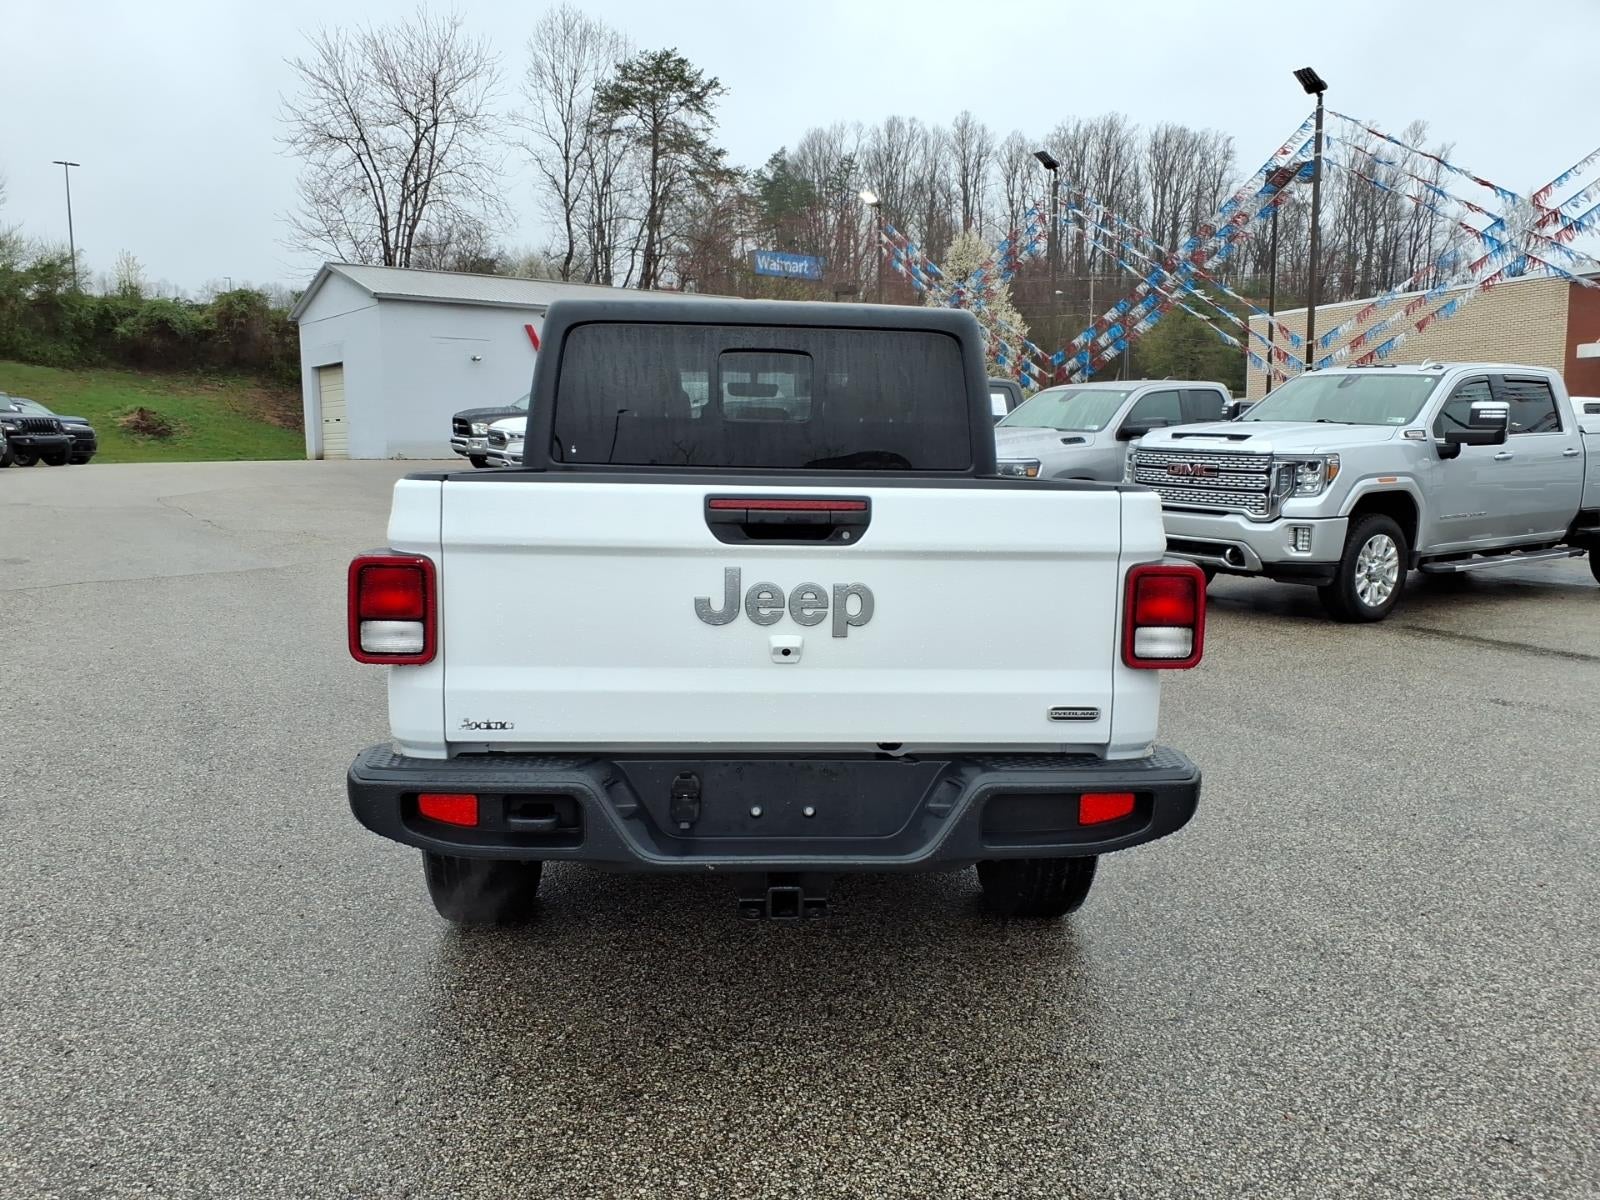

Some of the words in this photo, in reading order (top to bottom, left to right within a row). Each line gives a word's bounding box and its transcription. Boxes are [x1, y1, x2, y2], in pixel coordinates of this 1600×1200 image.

[757, 256, 809, 273] Walmart
[1167, 463, 1218, 477] GMC
[694, 567, 875, 638] Jeep
